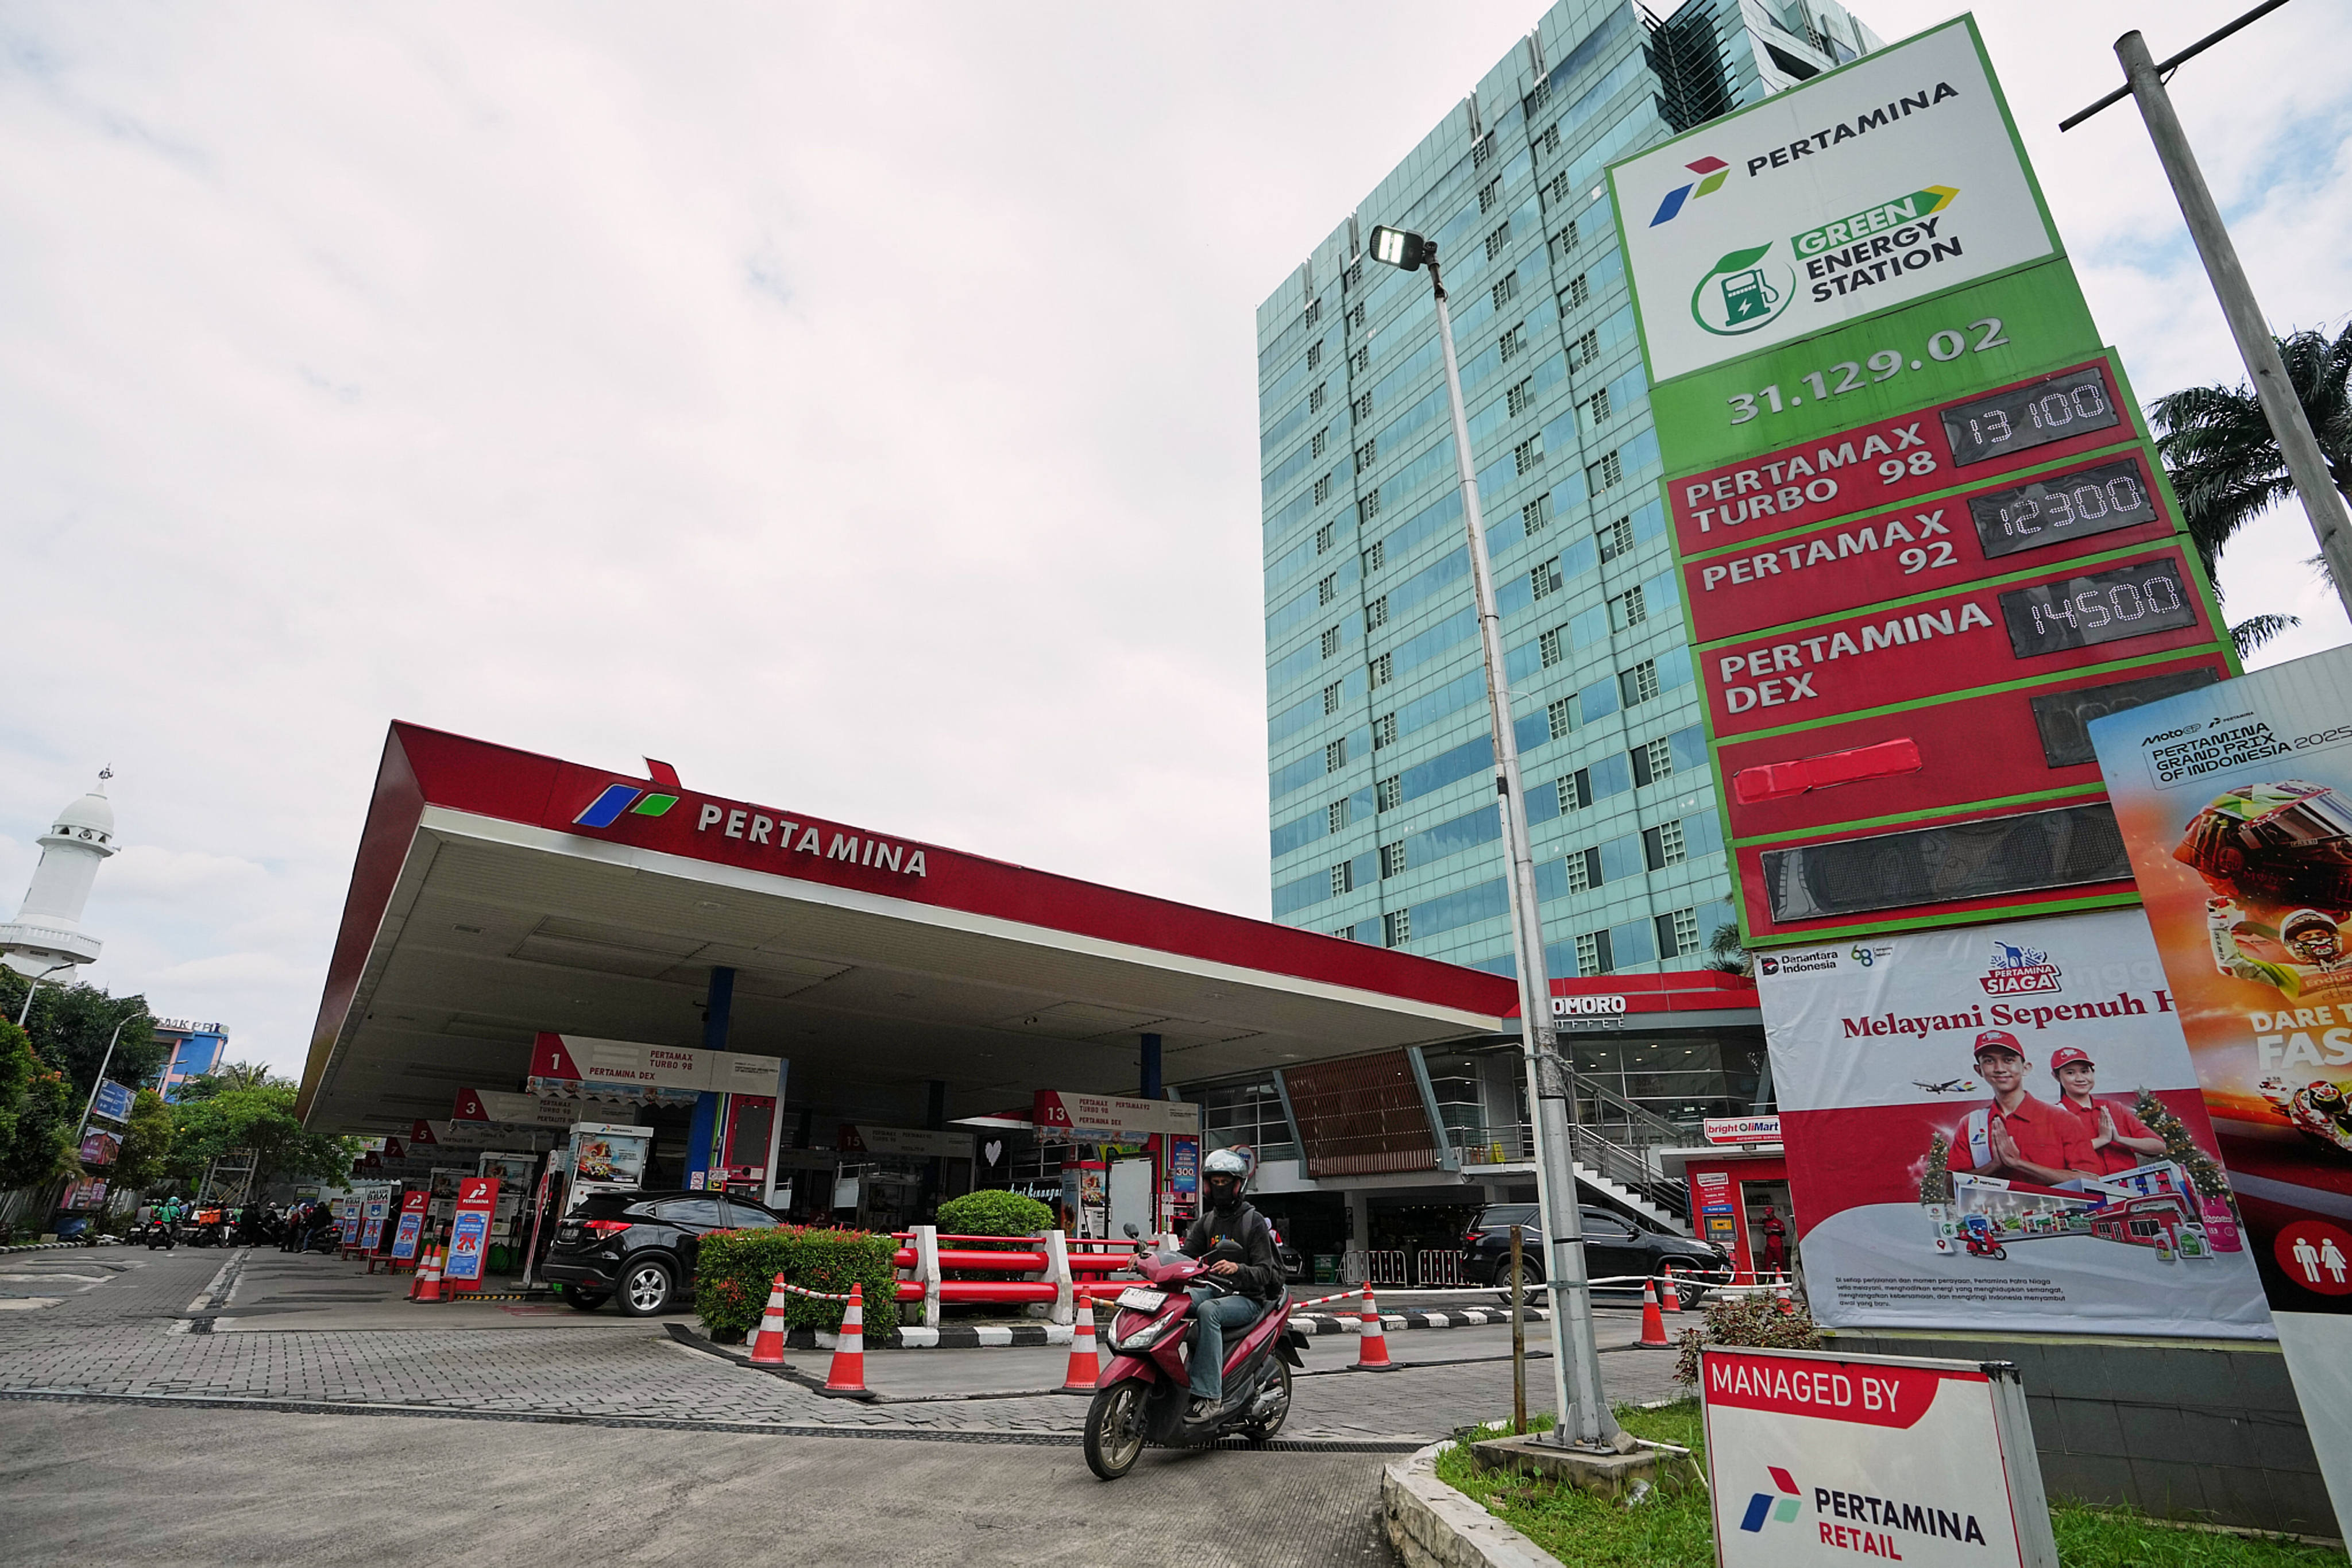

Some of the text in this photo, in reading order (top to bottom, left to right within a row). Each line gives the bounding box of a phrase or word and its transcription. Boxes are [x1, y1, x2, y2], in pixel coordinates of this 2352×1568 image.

[1747, 81, 1959, 177] PERTAMINA
[1797, 196, 1918, 254] GREEN
[1806, 216, 1940, 280] ENERGY
[1811, 236, 1963, 303] STATION
[1728, 316, 2010, 426] 31.129.02
[1686, 422, 1926, 509] PERTAMAX
[1690, 450, 1937, 533] TURBO 98
[2000, 476, 2142, 538] 12300
[1702, 509, 1951, 591] PERTAMAX
[1898, 541, 1957, 574] 92
[2031, 575, 2181, 635] 14500
[1719, 601, 1994, 683] PERTAMINA
[1725, 671, 1818, 715] DEX
[2141, 711, 2254, 747] MotoGP PERTAMINA
[2152, 723, 2270, 760] PERTAMINA
[2156, 732, 2277, 771] GRAND PRIX
[2160, 725, 2352, 782] OF INDONESIA 2025
[697, 804, 926, 877] PERTAMINA
[1782, 952, 1838, 964] Danantara
[1783, 960, 1836, 973] Indonesia
[1995, 965, 2053, 978] PERTAMINA
[1987, 975, 2053, 993] SIAGA
[1841, 1005, 1986, 1040] Melayani
[1991, 992, 2149, 1030] Sepenuh
[2249, 1006, 2334, 1032] DARE
[552, 1053, 559, 1069] 1
[650, 1050, 693, 1061] PERTAMAX
[650, 1059, 693, 1070] TURBO 98
[2257, 1027, 2352, 1071] FAS
[589, 1067, 655, 1080] PERTAMINA DEX
[465, 1102, 476, 1114] 3
[540, 1100, 571, 1108] PERTAMAX
[1048, 1107, 1065, 1121] 13
[1079, 1098, 1108, 1107] PERTAMAX
[419, 1129, 427, 1140] 5
[1079, 1117, 1109, 1125] PERTAMINA
[1709, 1124, 1738, 1134] bright
[391, 1146, 397, 1154] 7
[847, 1136, 860, 1147] 15
[1176, 1168, 1194, 1176] 300
[368, 1193, 387, 1201] BBM
[457, 1235, 476, 1250] 2X
[1712, 1362, 1899, 1412] MANAGED BY
[1815, 1487, 1986, 1546] PERTAMINA
[1818, 1521, 1902, 1561] RETAIL
